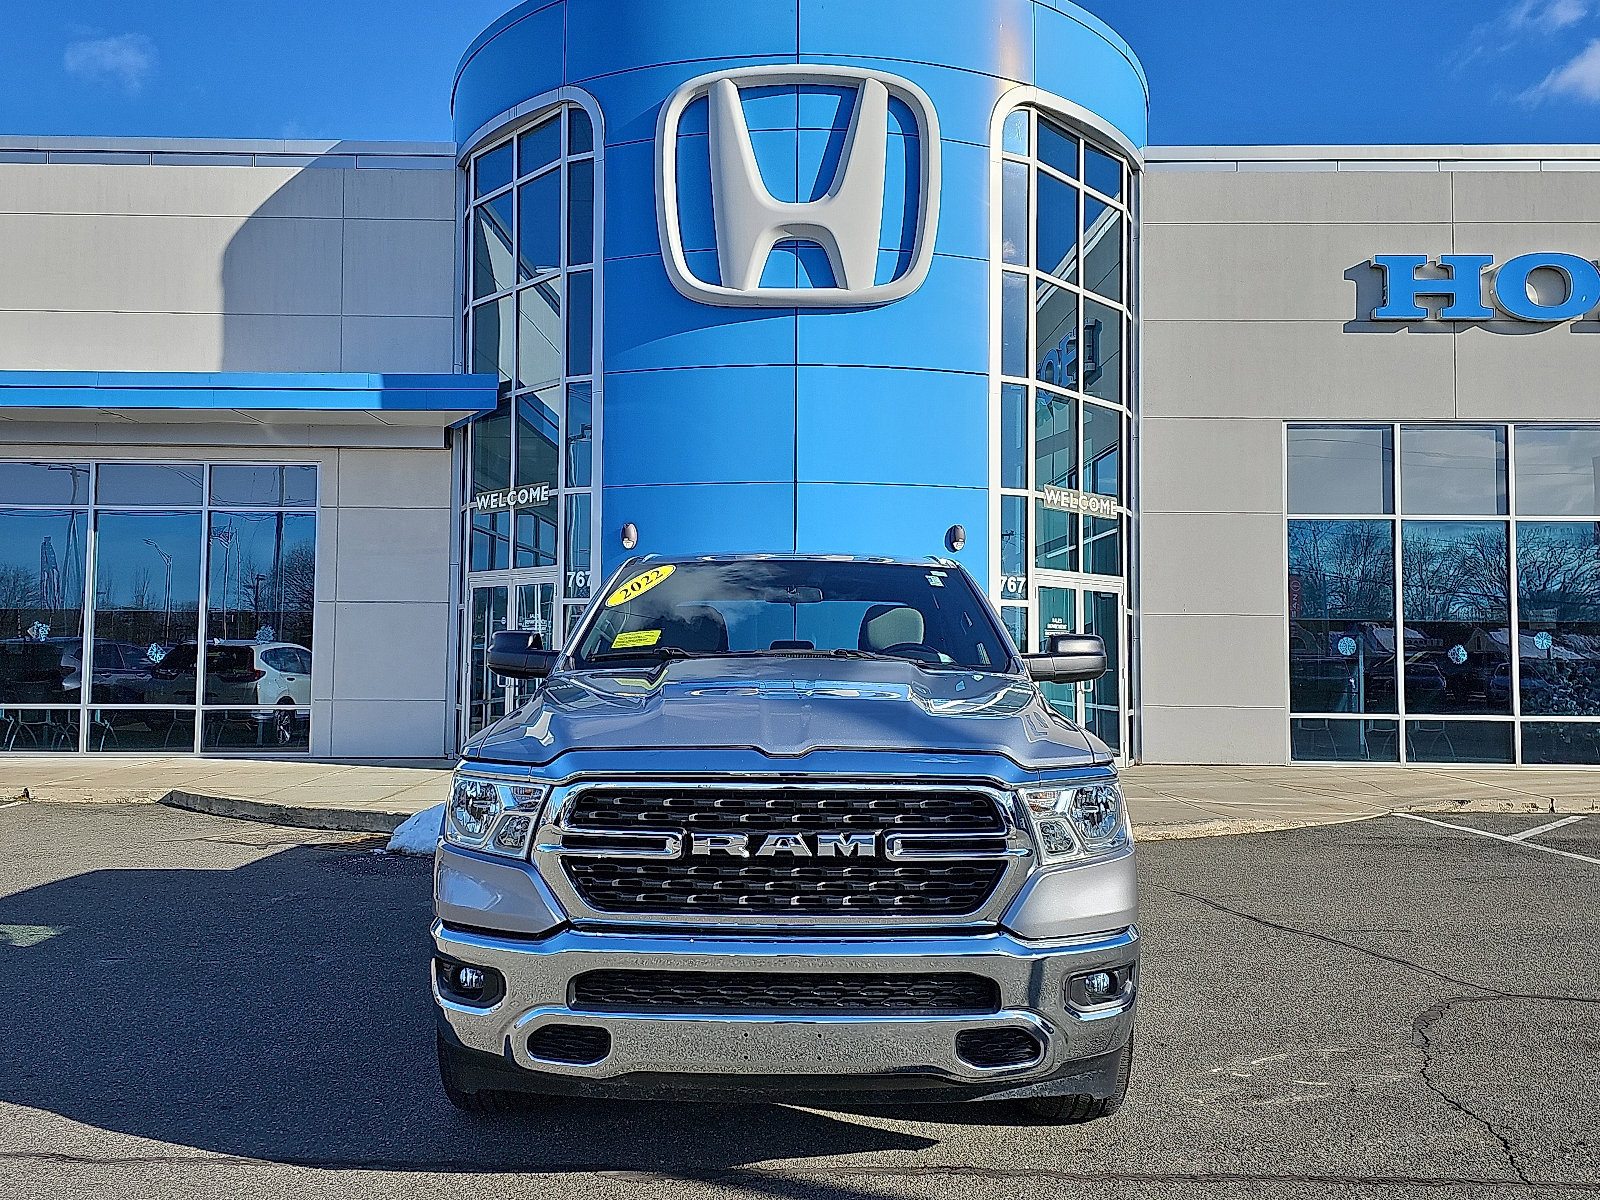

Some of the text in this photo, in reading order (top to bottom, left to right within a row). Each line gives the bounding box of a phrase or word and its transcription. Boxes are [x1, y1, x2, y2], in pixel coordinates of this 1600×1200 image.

[476, 486, 549, 510] WELCOME
[1045, 488, 1117, 515] WELCOME
[566, 571, 592, 588] 767
[619, 570, 664, 600] 2022
[1000, 576, 1027, 594] 767
[692, 833, 875, 857] RAM
